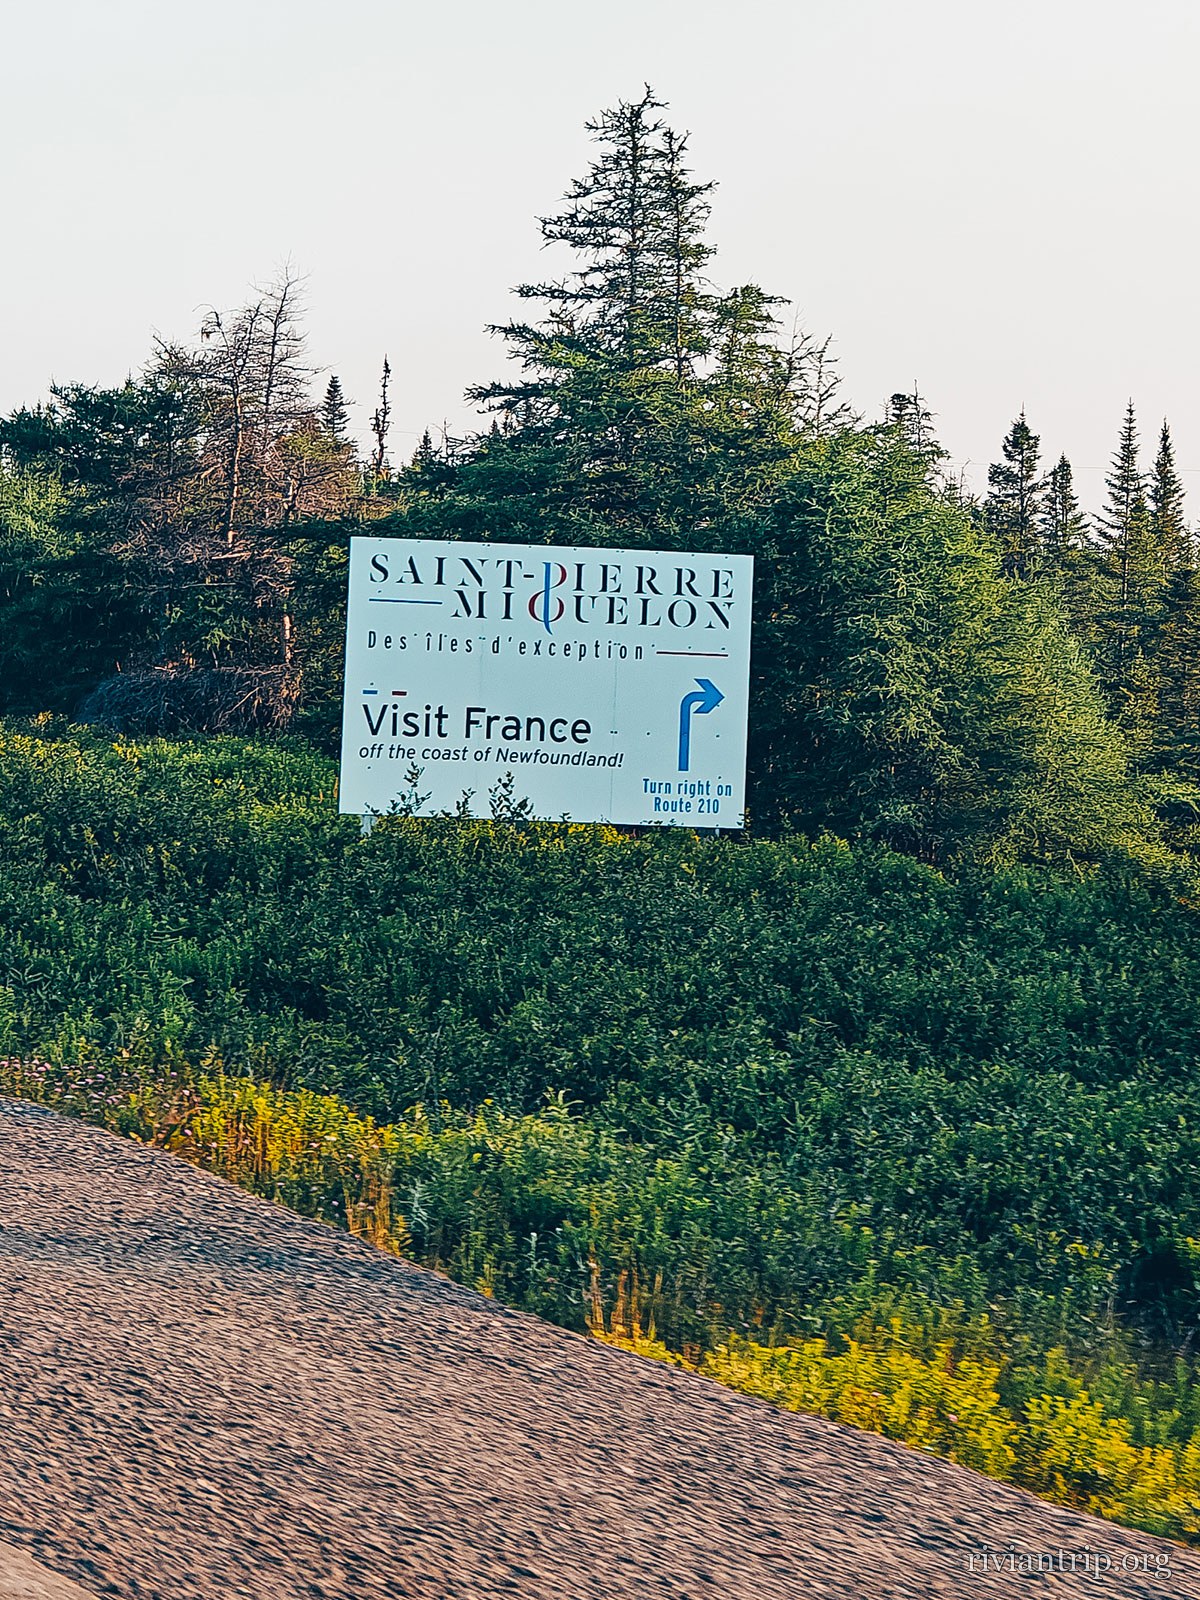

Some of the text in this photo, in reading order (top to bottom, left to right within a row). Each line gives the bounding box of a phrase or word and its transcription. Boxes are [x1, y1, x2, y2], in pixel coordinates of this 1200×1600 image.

[369, 553, 734, 599] SAINT-PIERRE
[450, 589, 735, 635] MIQUELON
[368, 630, 643, 662] Des îles d'exception
[362, 703, 592, 744] Visit France
[359, 743, 624, 768] off the coast of Newfoundland!
[642, 778, 732, 799] Turn right on
[654, 797, 719, 814] Route 210
